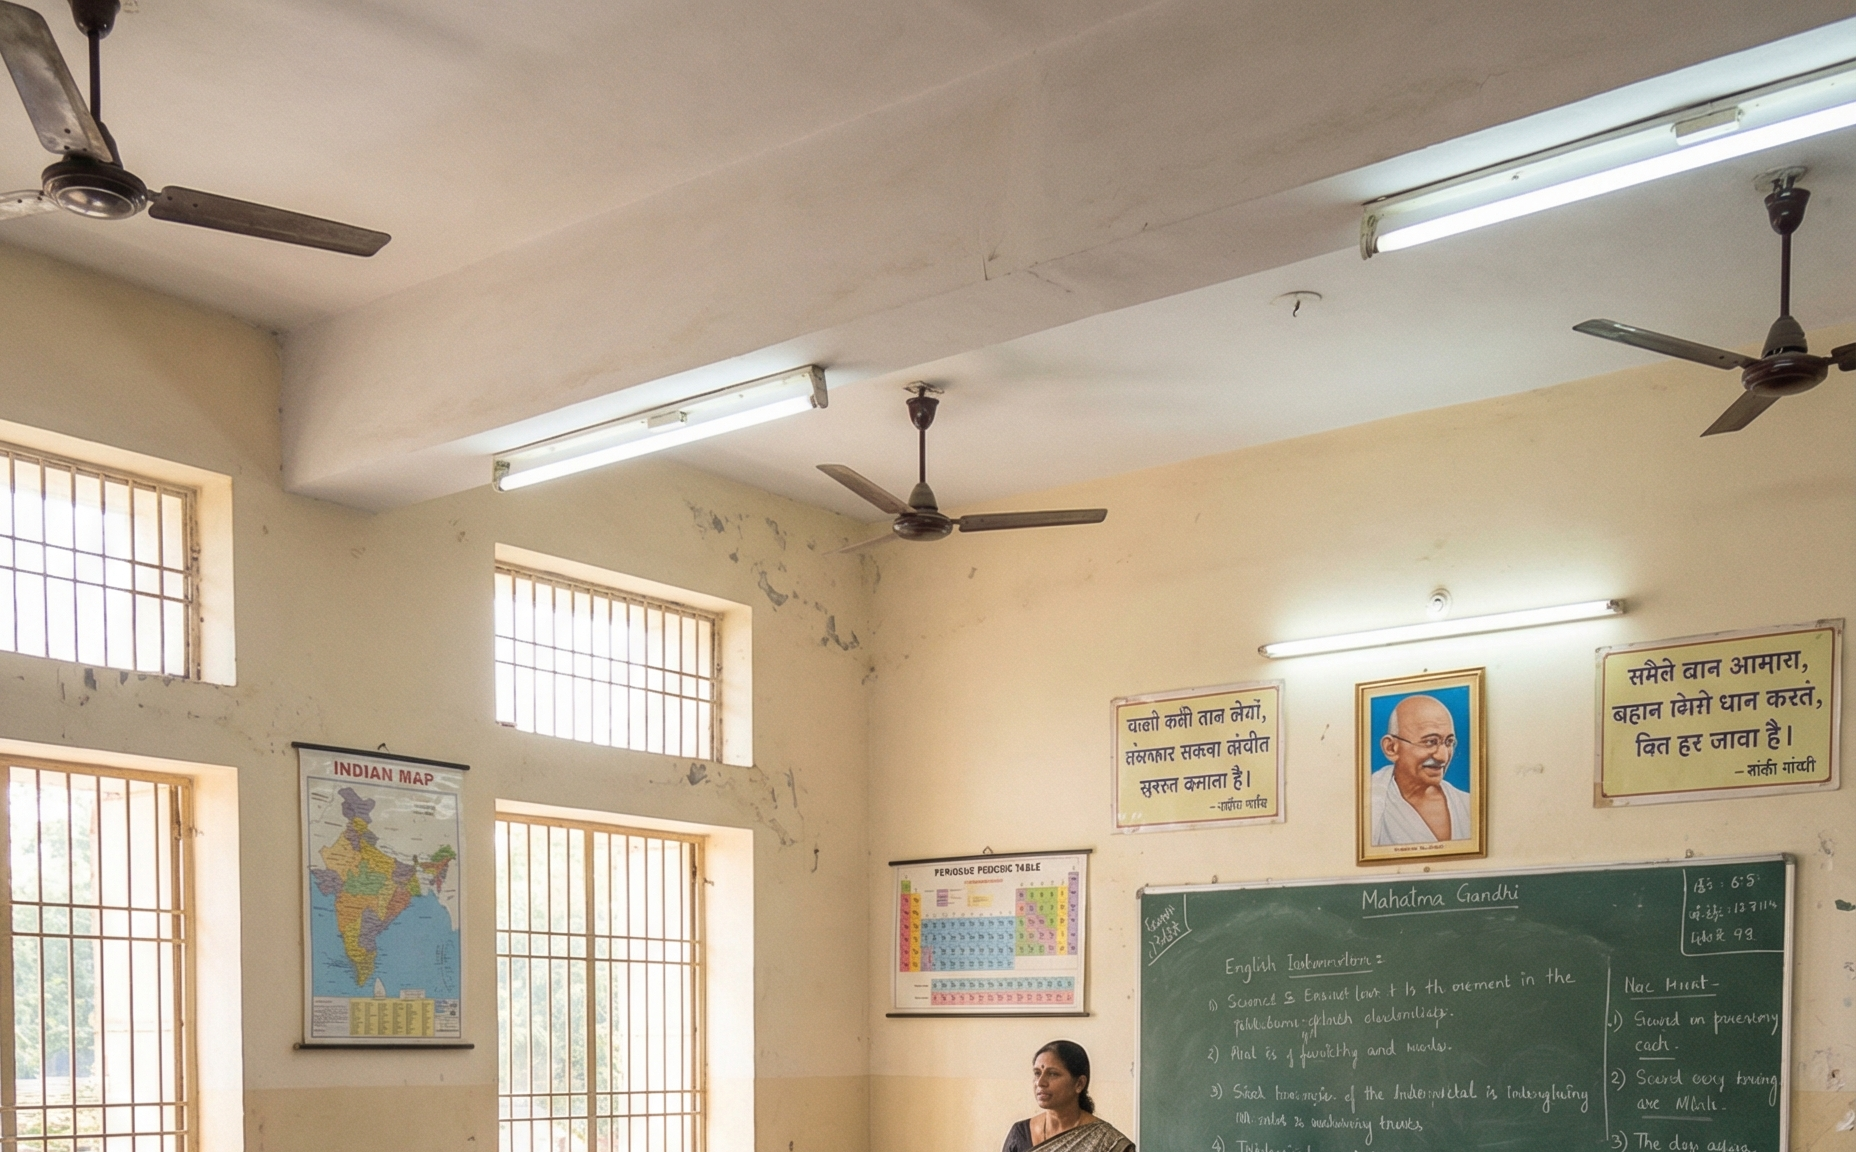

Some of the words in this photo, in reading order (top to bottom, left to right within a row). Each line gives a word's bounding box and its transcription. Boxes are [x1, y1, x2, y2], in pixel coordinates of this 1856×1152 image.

[333, 760, 393, 781] INDIAN
[399, 769, 434, 786] MAP
[1362, 885, 1445, 910] Mahatma
[1456, 882, 1519, 903] Gandhi
[1225, 955, 1277, 984] English
[1520, 971, 1535, 986] in
[1545, 967, 1576, 985] the
[1367, 1038, 1397, 1056] and
[1611, 1067, 1626, 1092] 2)
[1364, 1085, 1385, 1101] the
[1633, 1132, 1662, 1151] The
